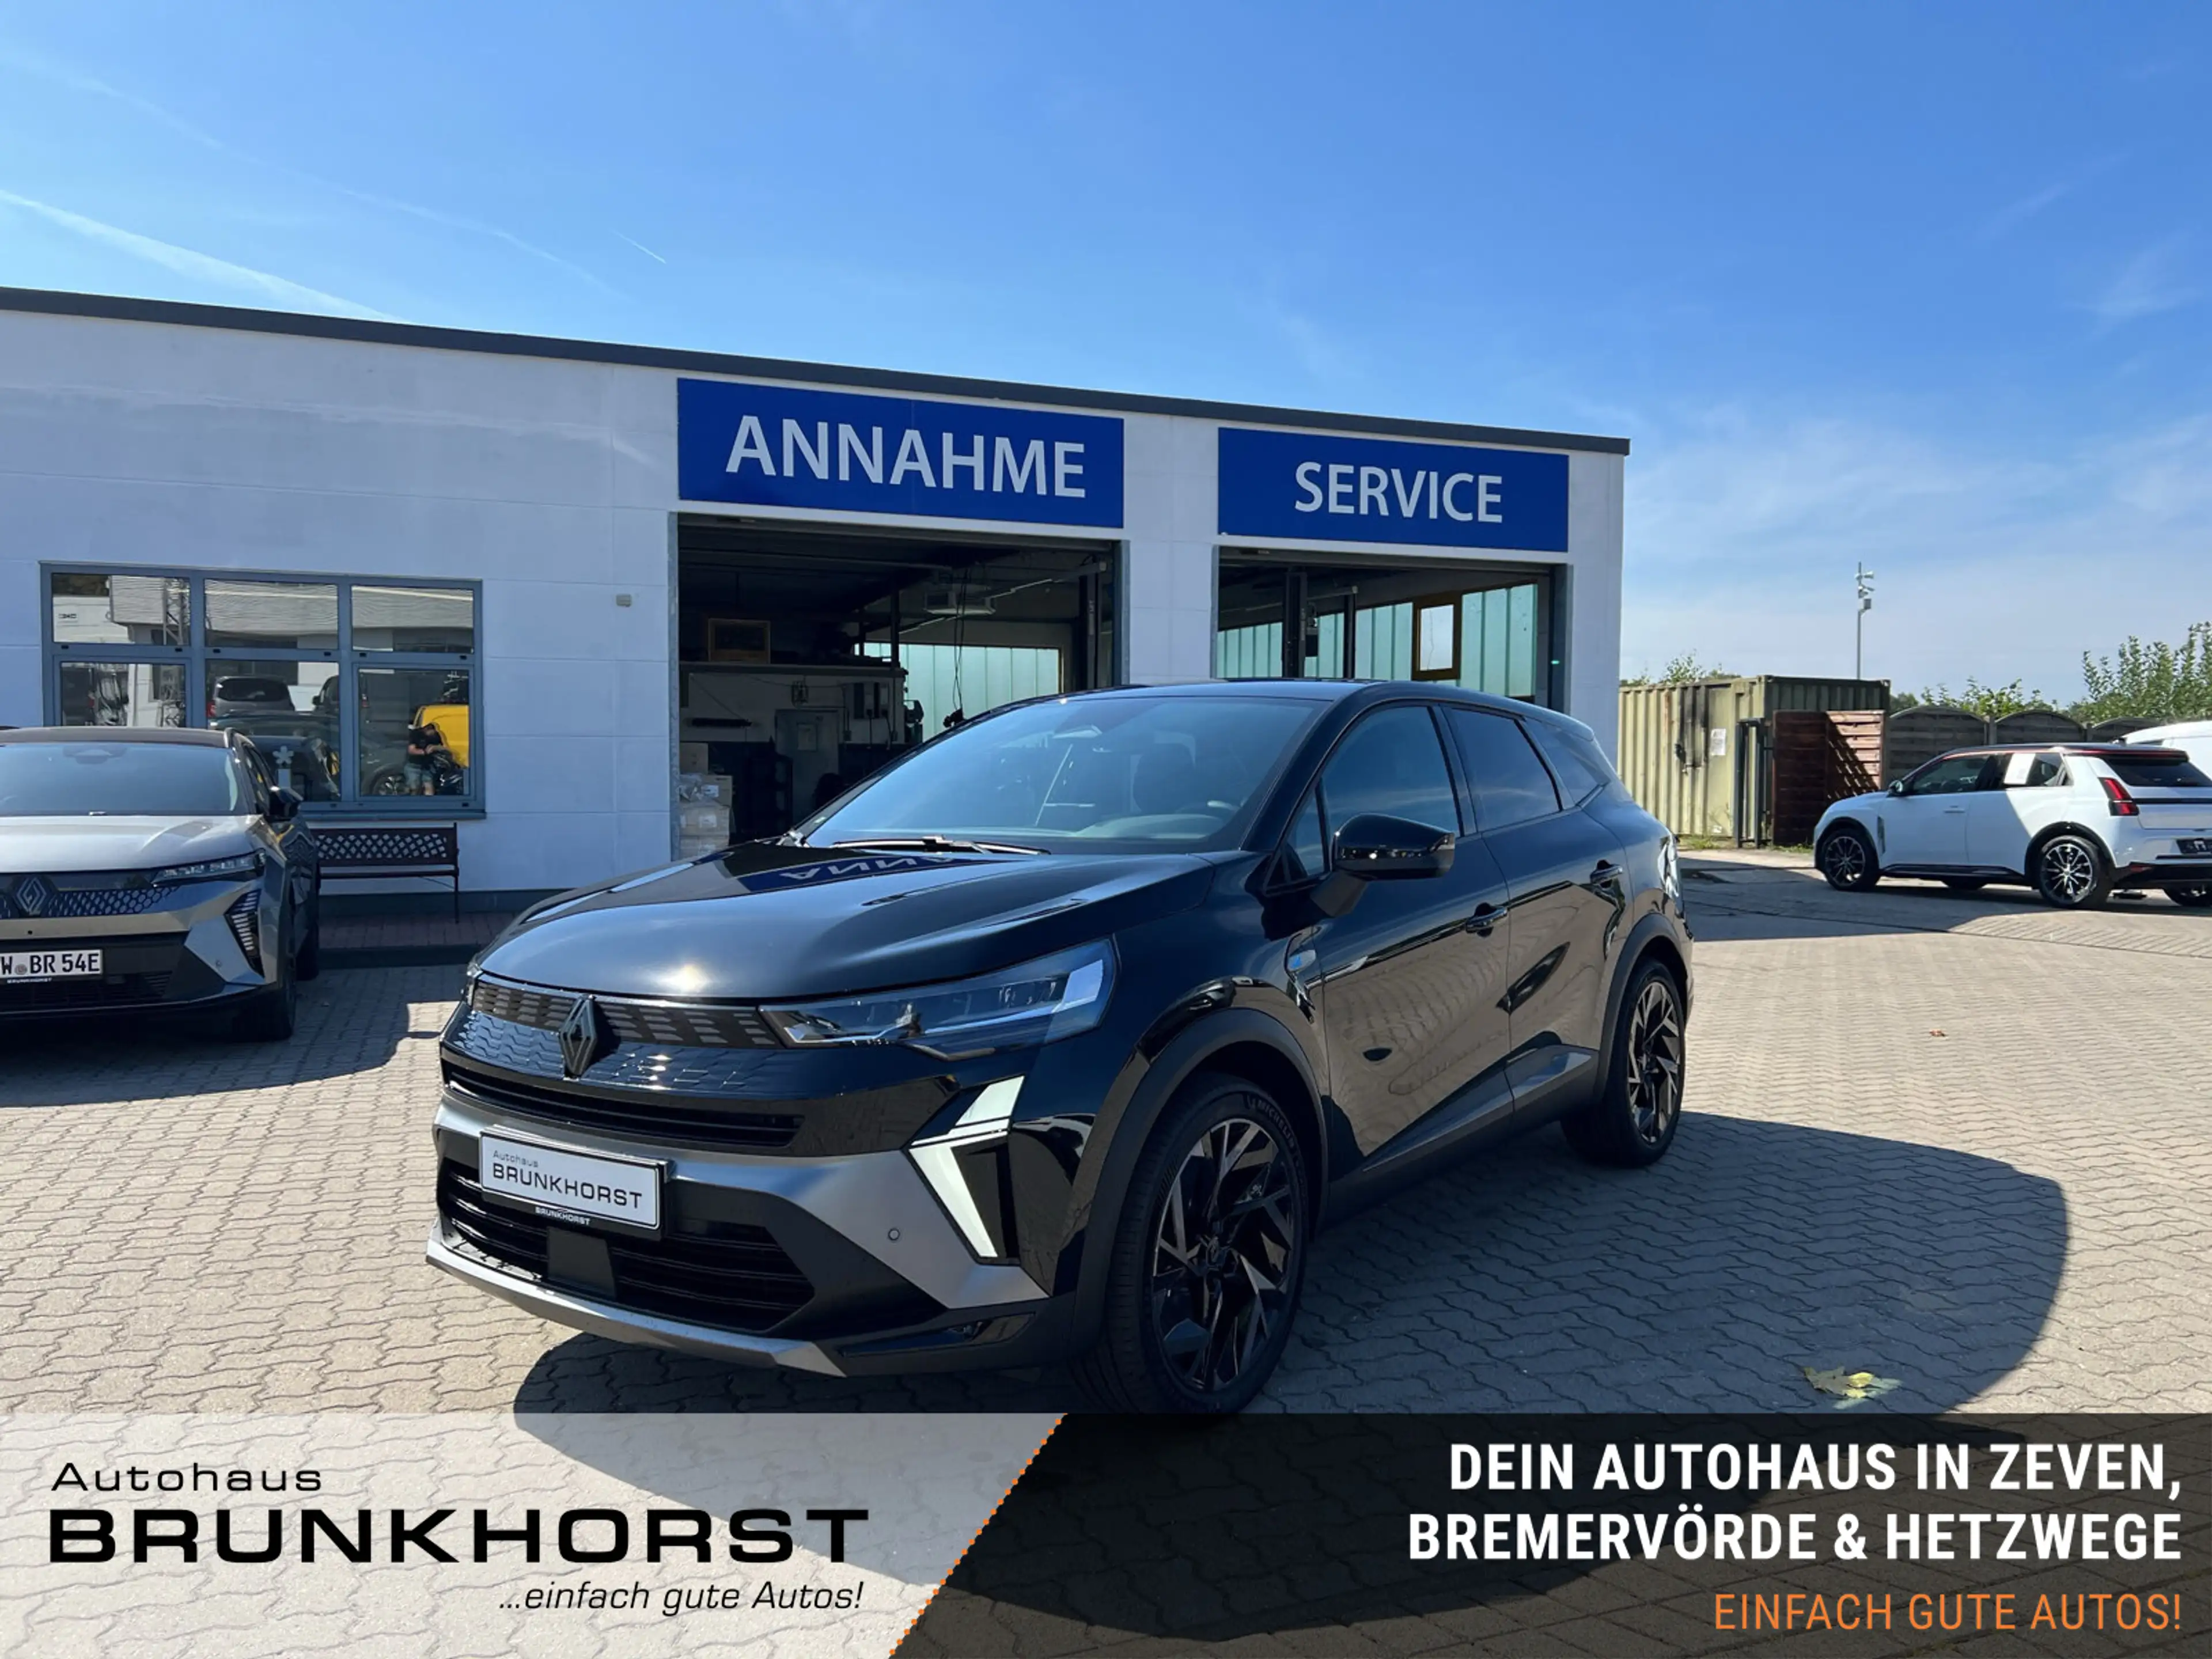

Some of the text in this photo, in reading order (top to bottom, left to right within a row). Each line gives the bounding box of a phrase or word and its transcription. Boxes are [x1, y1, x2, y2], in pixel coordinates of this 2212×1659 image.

[726, 415, 1085, 499] ANNAHME
[1295, 461, 1503, 523] SERVICE
[1, 953, 100, 975] W BR 54E
[493, 1150, 539, 1168] Autohaus
[493, 1163, 642, 1209] BRUNKHORST
[535, 1207, 590, 1225] BRUNKHORST
